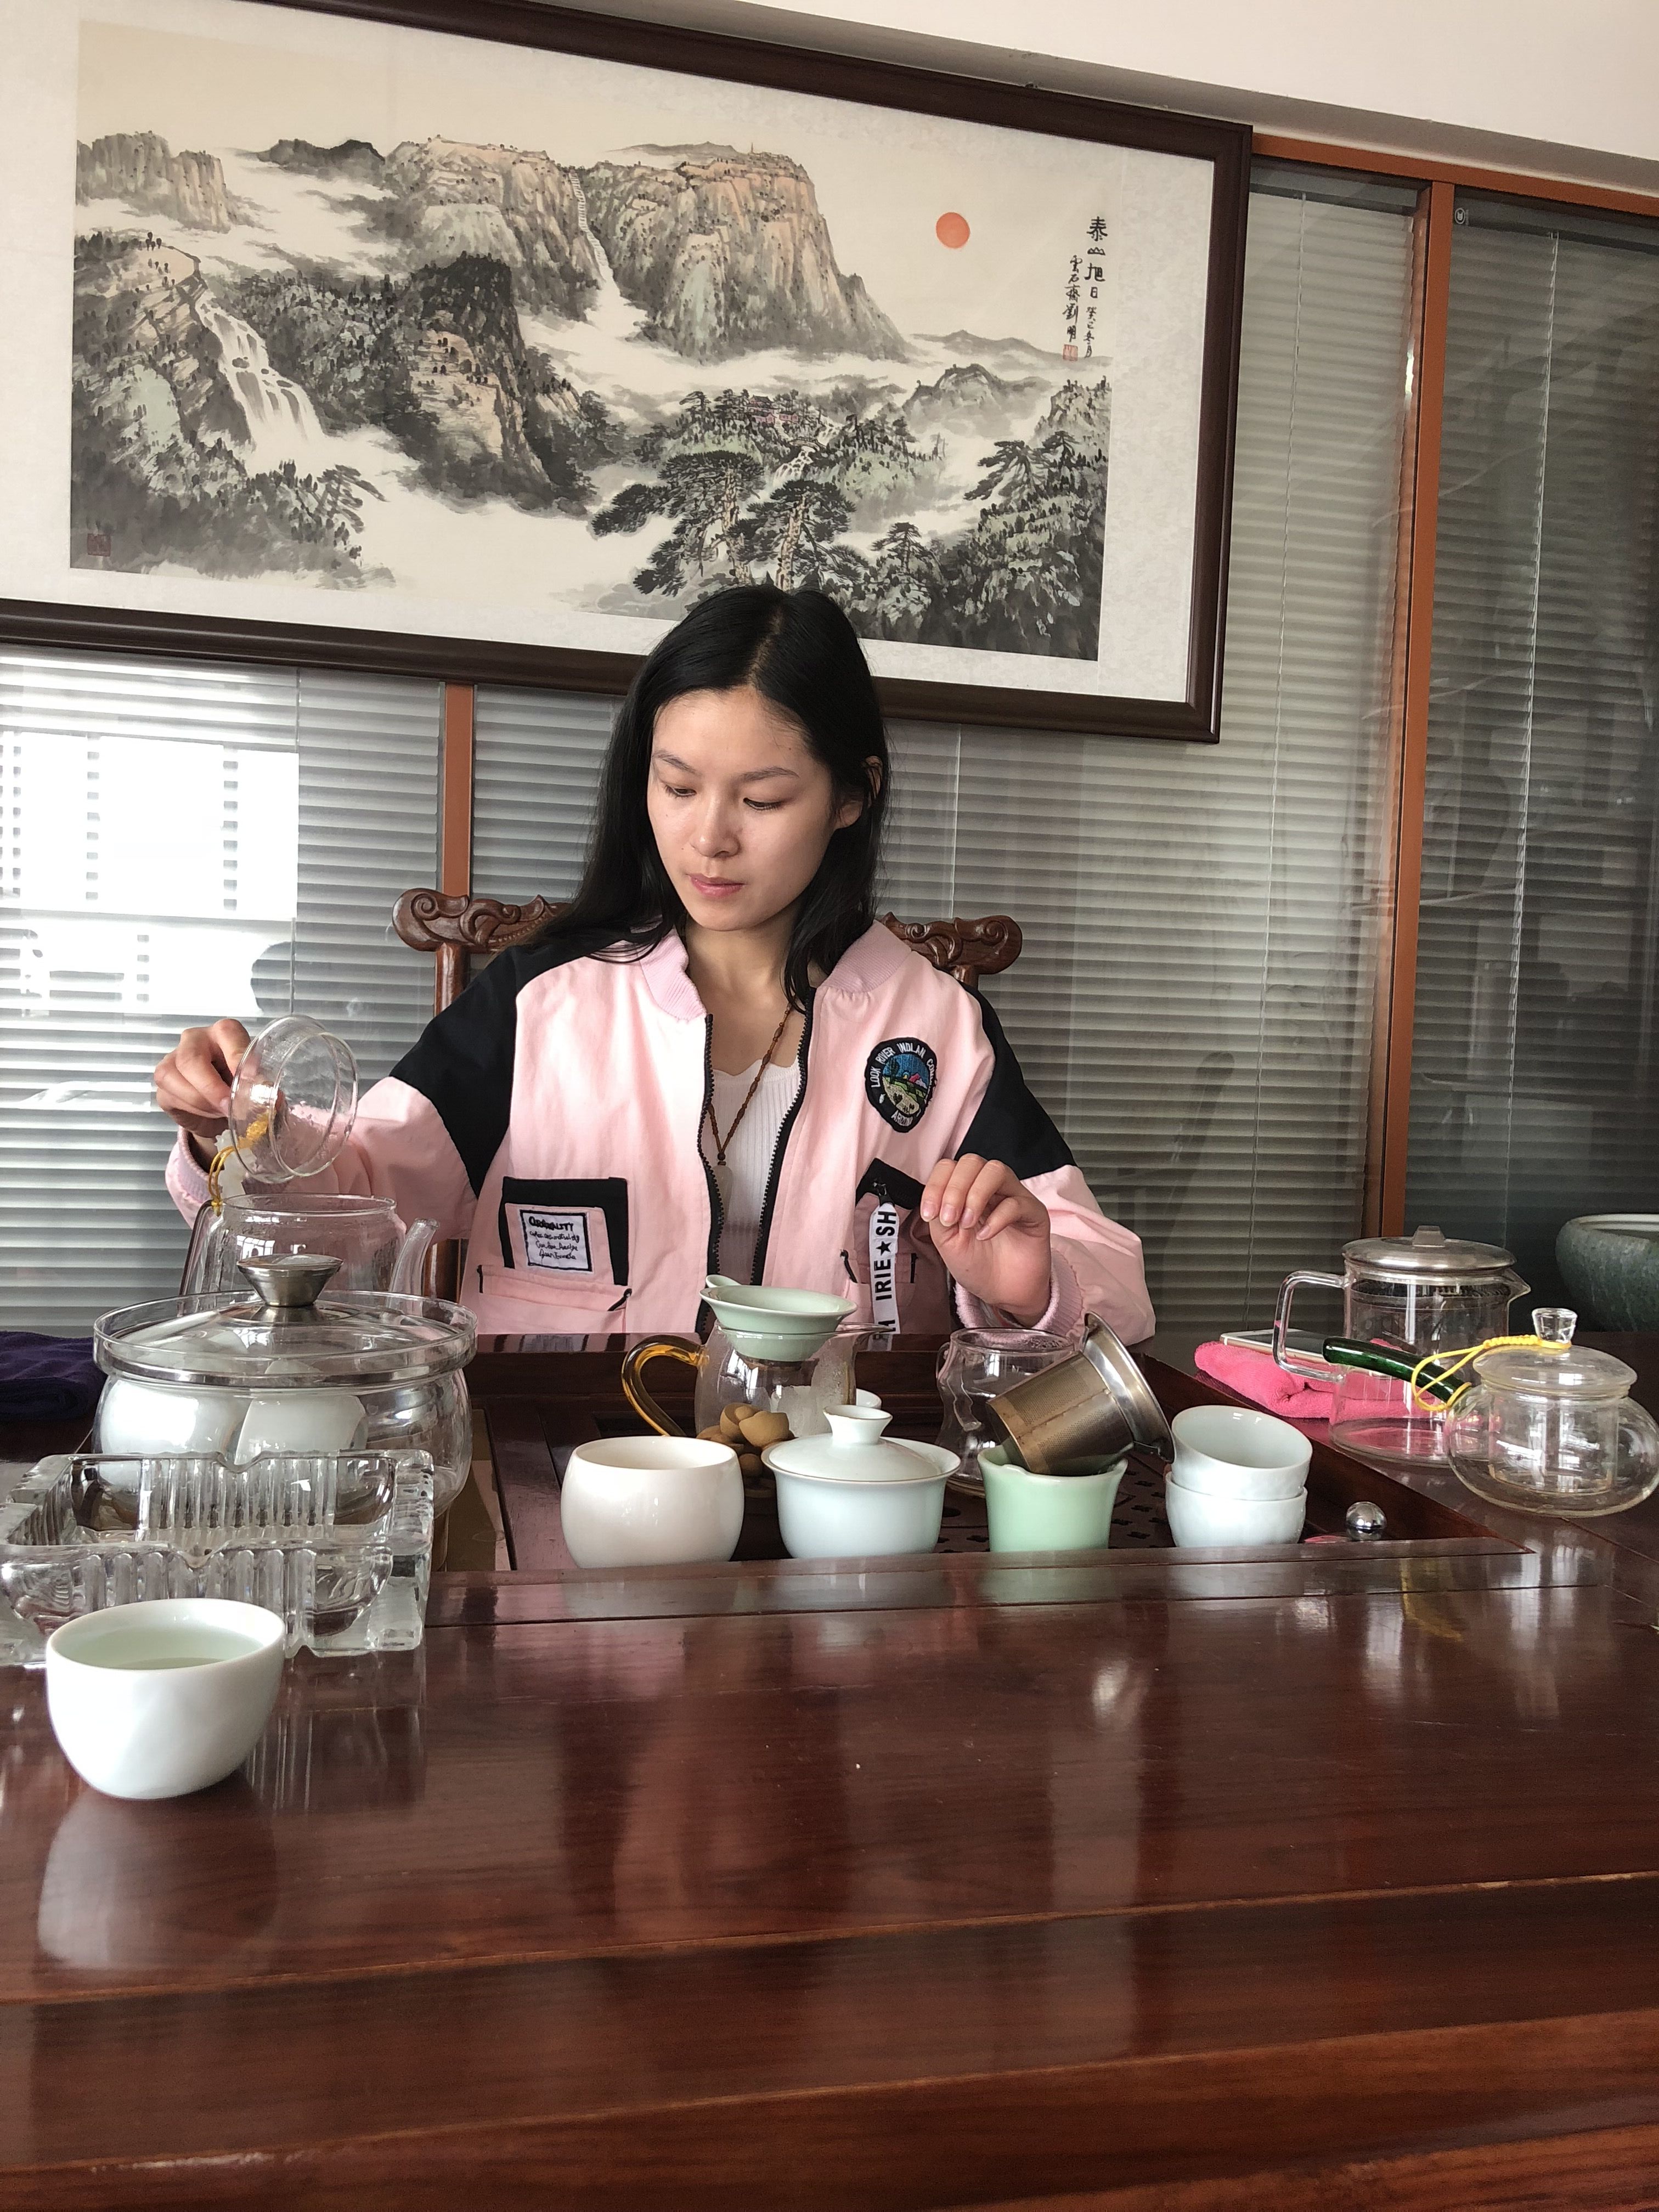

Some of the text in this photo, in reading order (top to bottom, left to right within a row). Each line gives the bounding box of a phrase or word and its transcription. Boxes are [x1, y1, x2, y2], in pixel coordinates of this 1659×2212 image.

[1084, 216, 1108, 298] 泰山旭日
[875, 1047, 896, 1065] RIVER
[870, 1066, 881, 1088] LOOK
[876, 1211, 897, 1237] SH
[874, 1259, 892, 1301] IRIE
